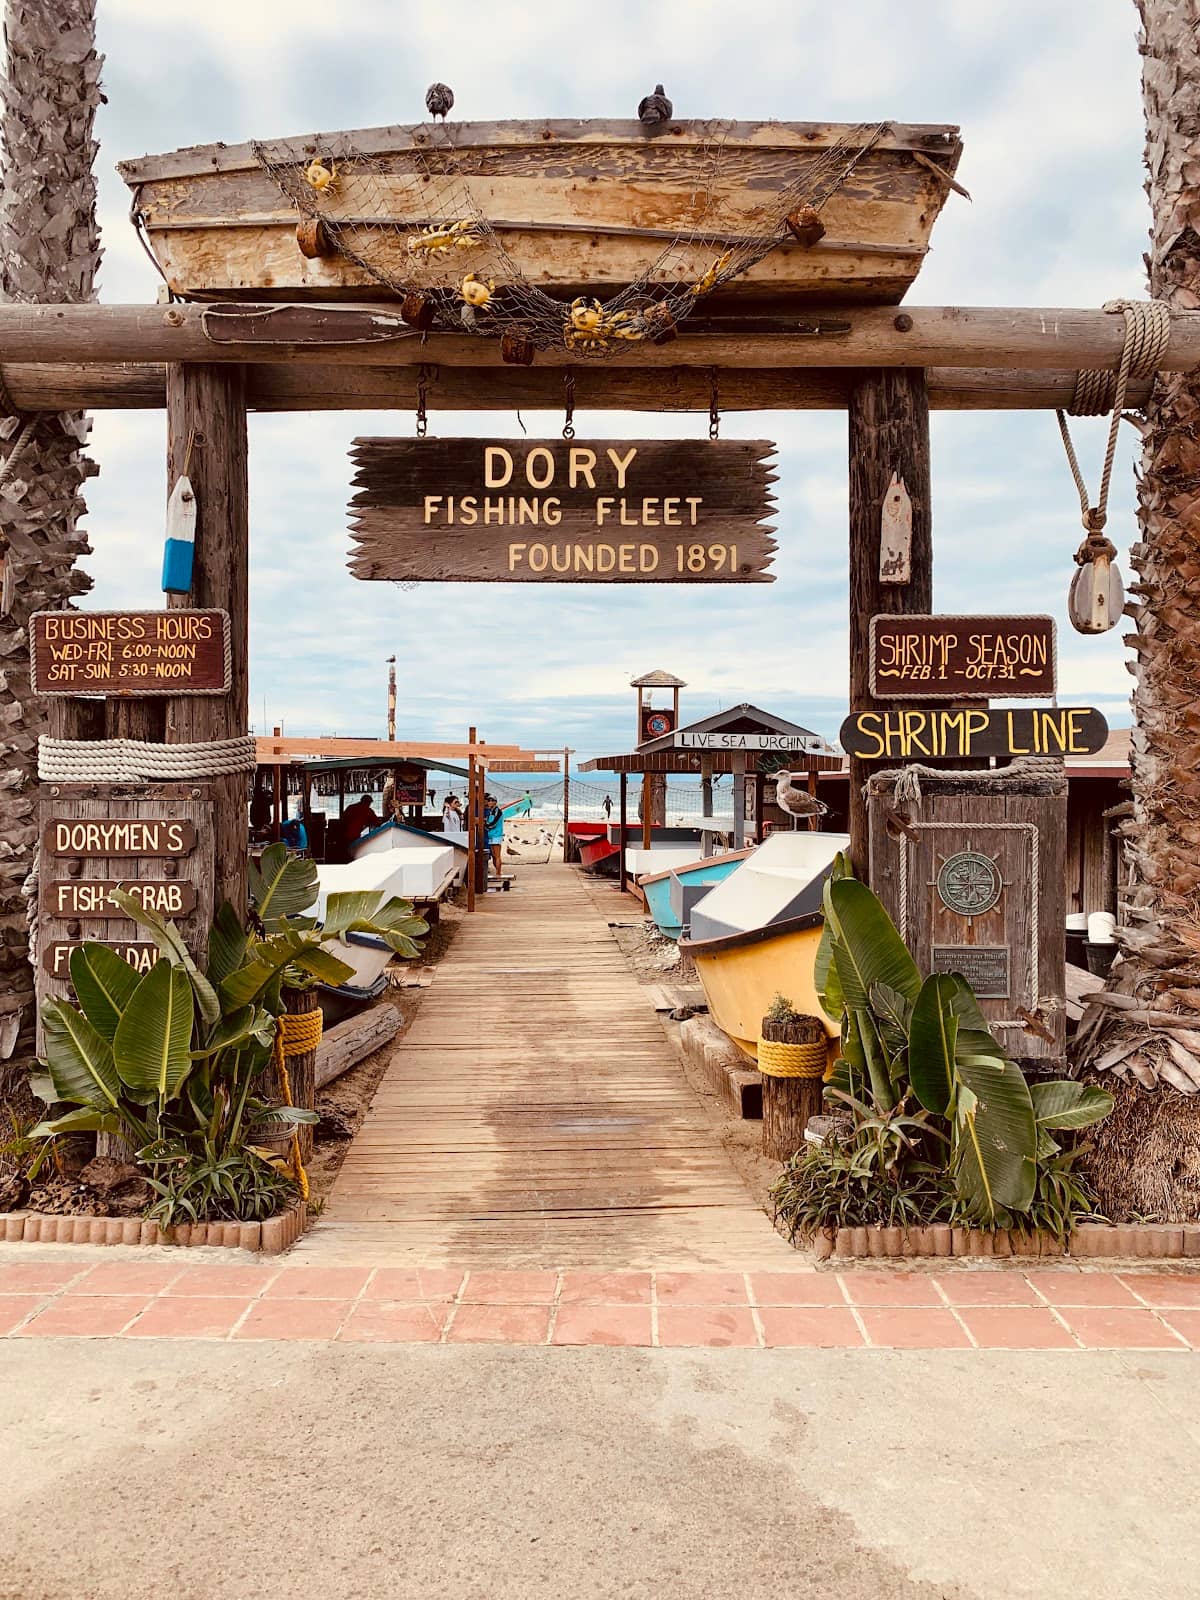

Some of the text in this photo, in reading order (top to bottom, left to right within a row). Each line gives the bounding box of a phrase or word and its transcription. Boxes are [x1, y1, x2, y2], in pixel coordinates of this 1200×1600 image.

[484, 446, 638, 490] DORY
[423, 495, 703, 526] FISHING FLEET
[508, 543, 738, 573] FOUNDED 1891
[45, 616, 212, 641] BUSINESS HOURS
[879, 634, 1047, 666] SHRIMP SEASON
[681, 732, 807, 751] LIVE SEA URCHIN
[854, 709, 1092, 759] SHRIMP LINE
[56, 822, 183, 852] DORYMEN'S
[58, 885, 104, 912] FISH
